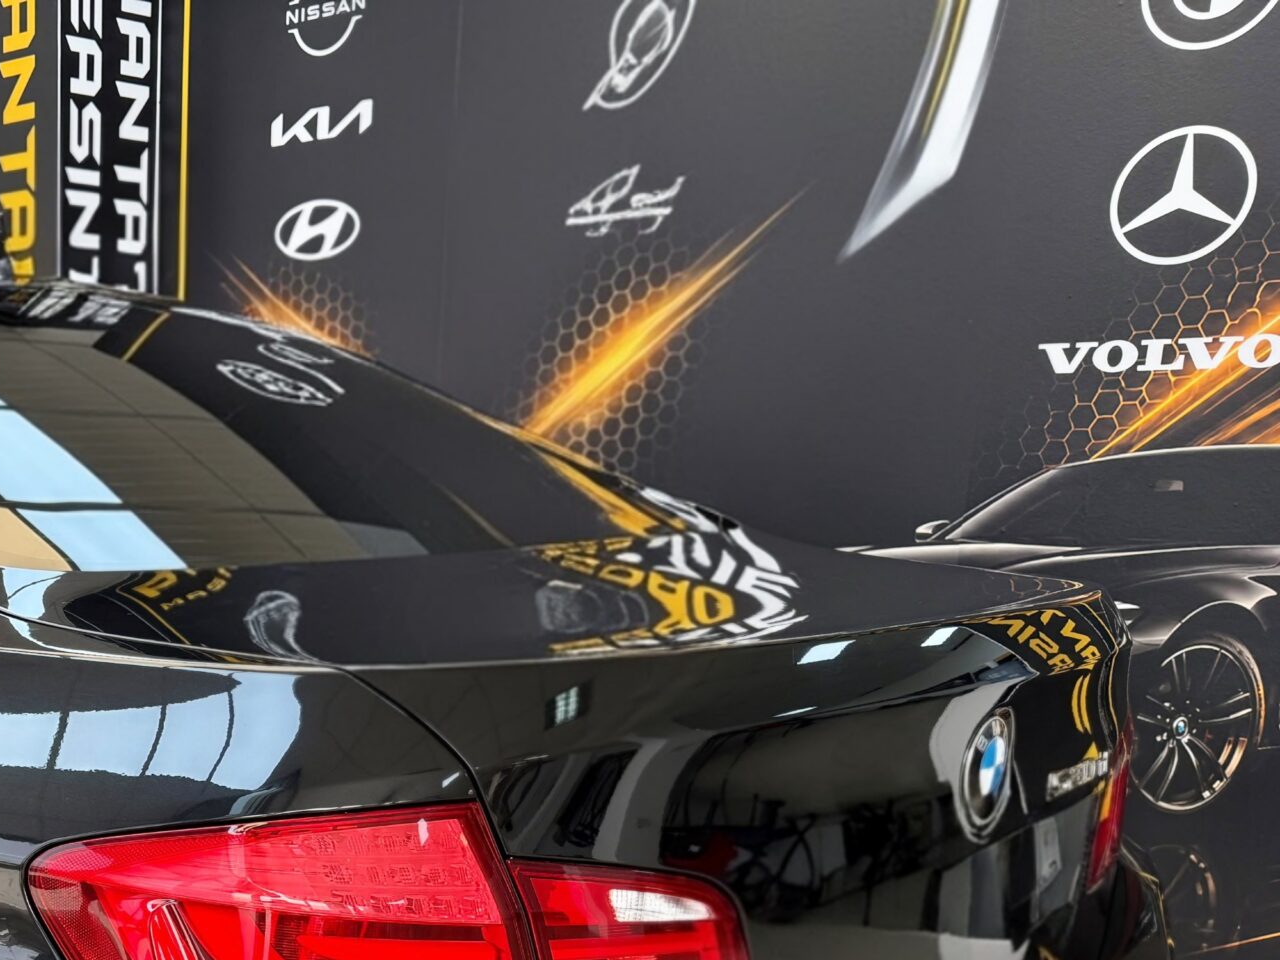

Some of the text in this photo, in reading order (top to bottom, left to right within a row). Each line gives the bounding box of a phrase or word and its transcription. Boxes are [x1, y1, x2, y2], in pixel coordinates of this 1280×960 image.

[286, 0, 366, 25] NISSAN
[271, 98, 373, 147] KIA
[1038, 333, 1280, 374] VOLVO
